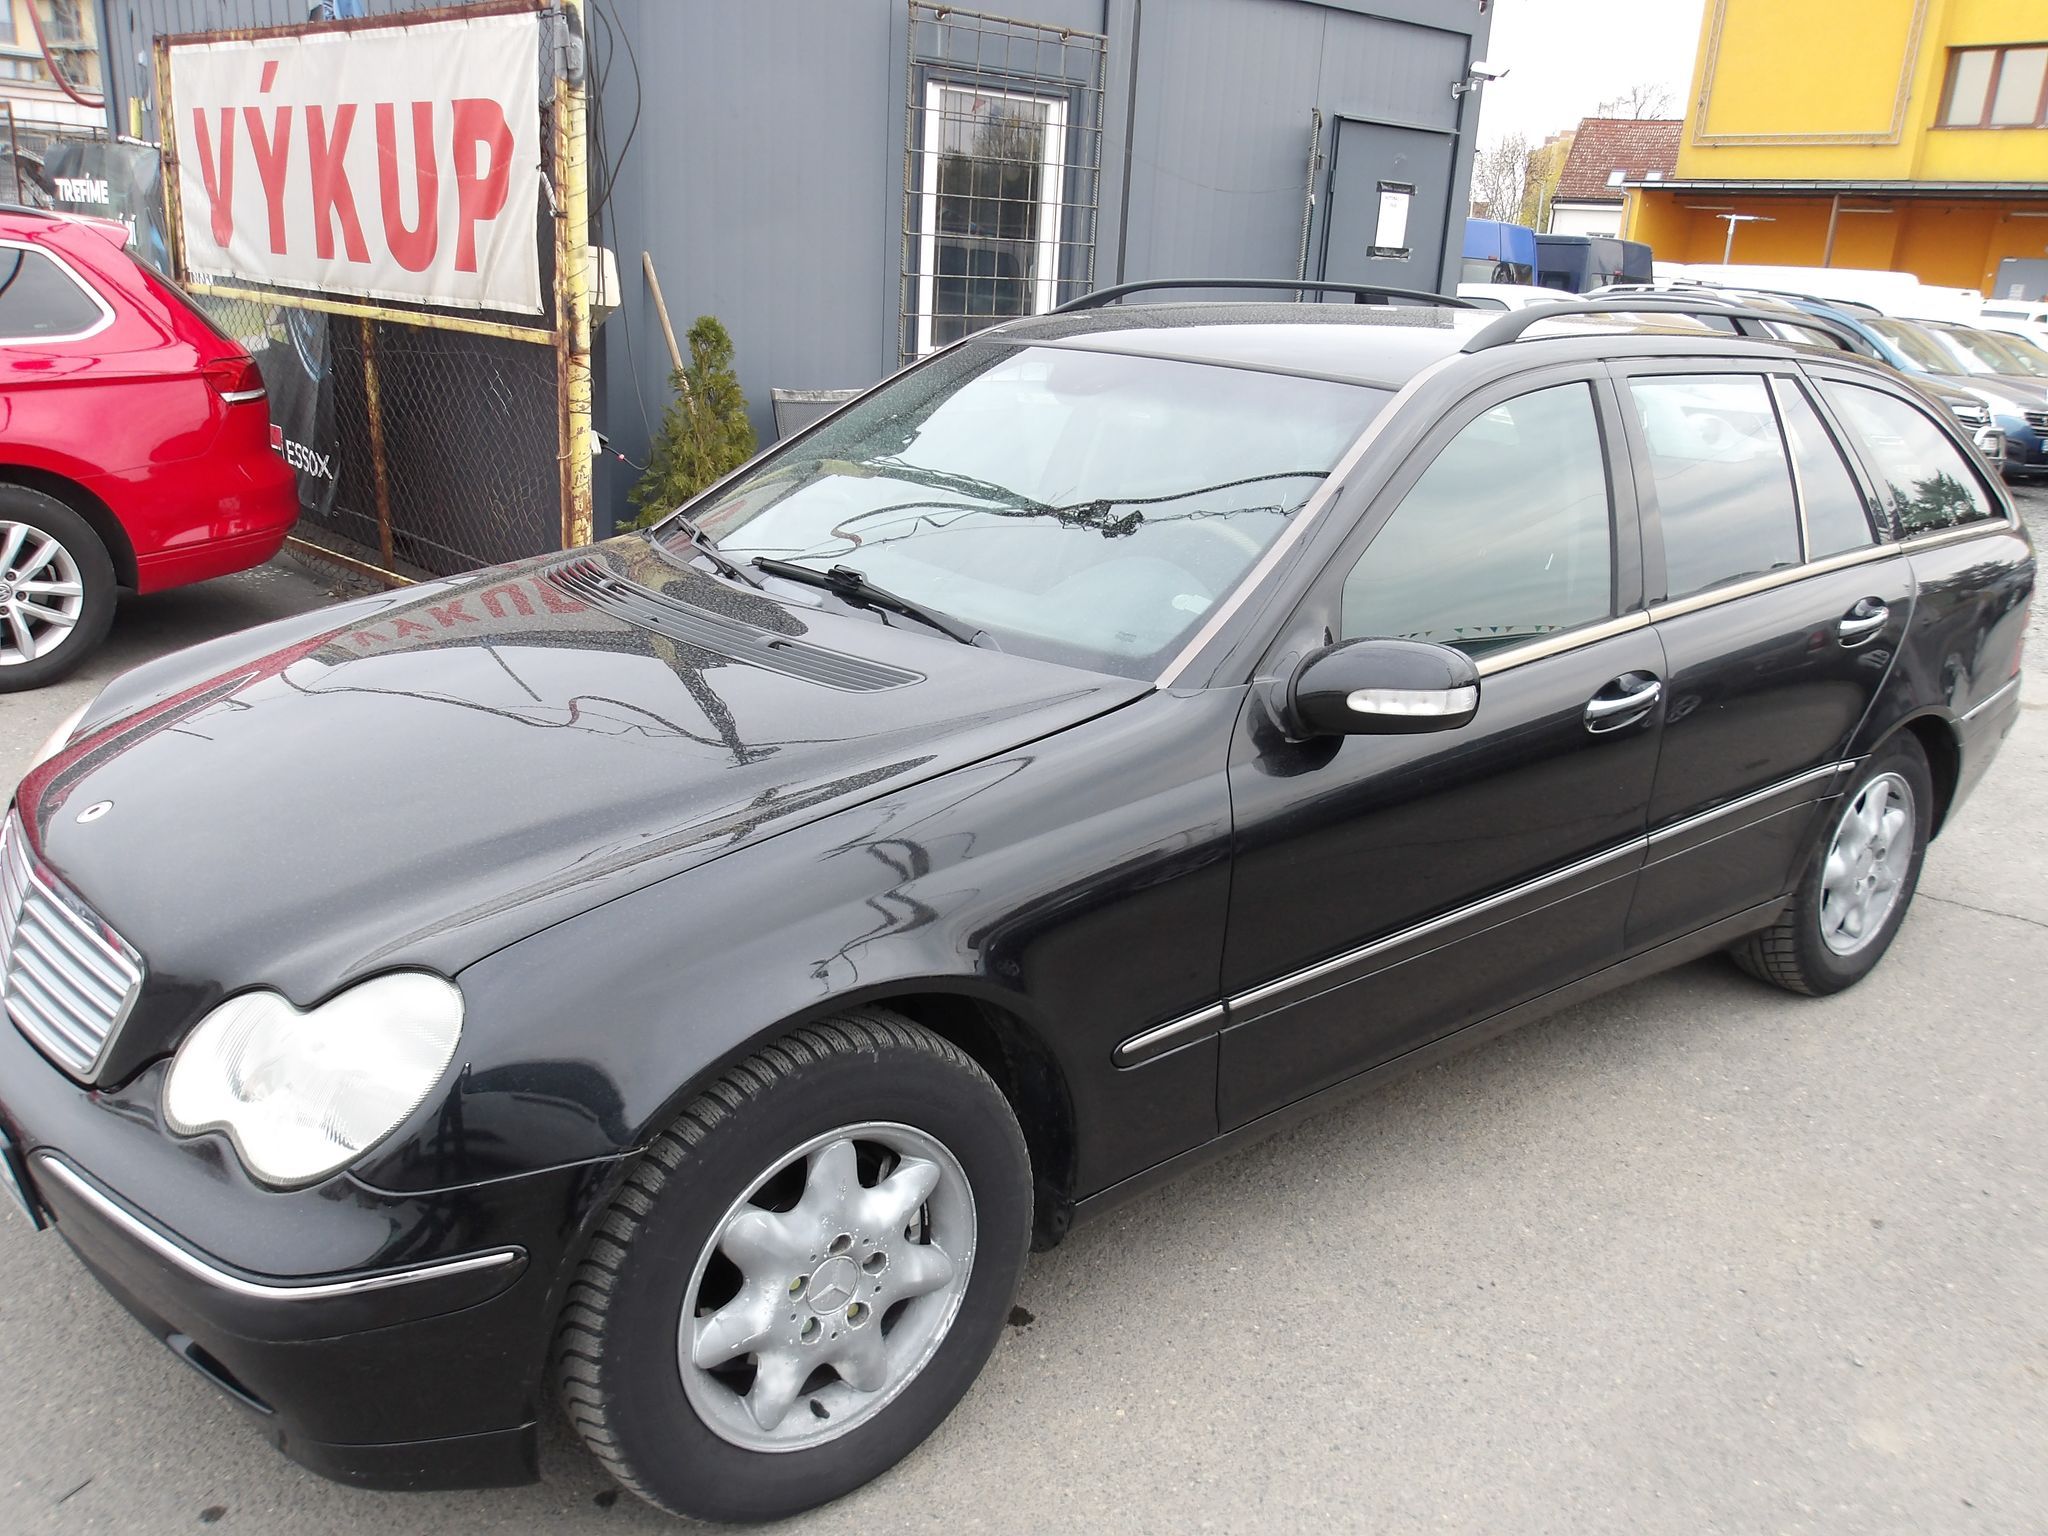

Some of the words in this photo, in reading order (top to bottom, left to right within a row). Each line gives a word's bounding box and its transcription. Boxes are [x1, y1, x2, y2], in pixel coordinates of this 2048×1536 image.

[192, 60, 515, 273] VÝKUP
[54, 172, 110, 205] TREFÍME
[285, 439, 333, 480] ESSOX
